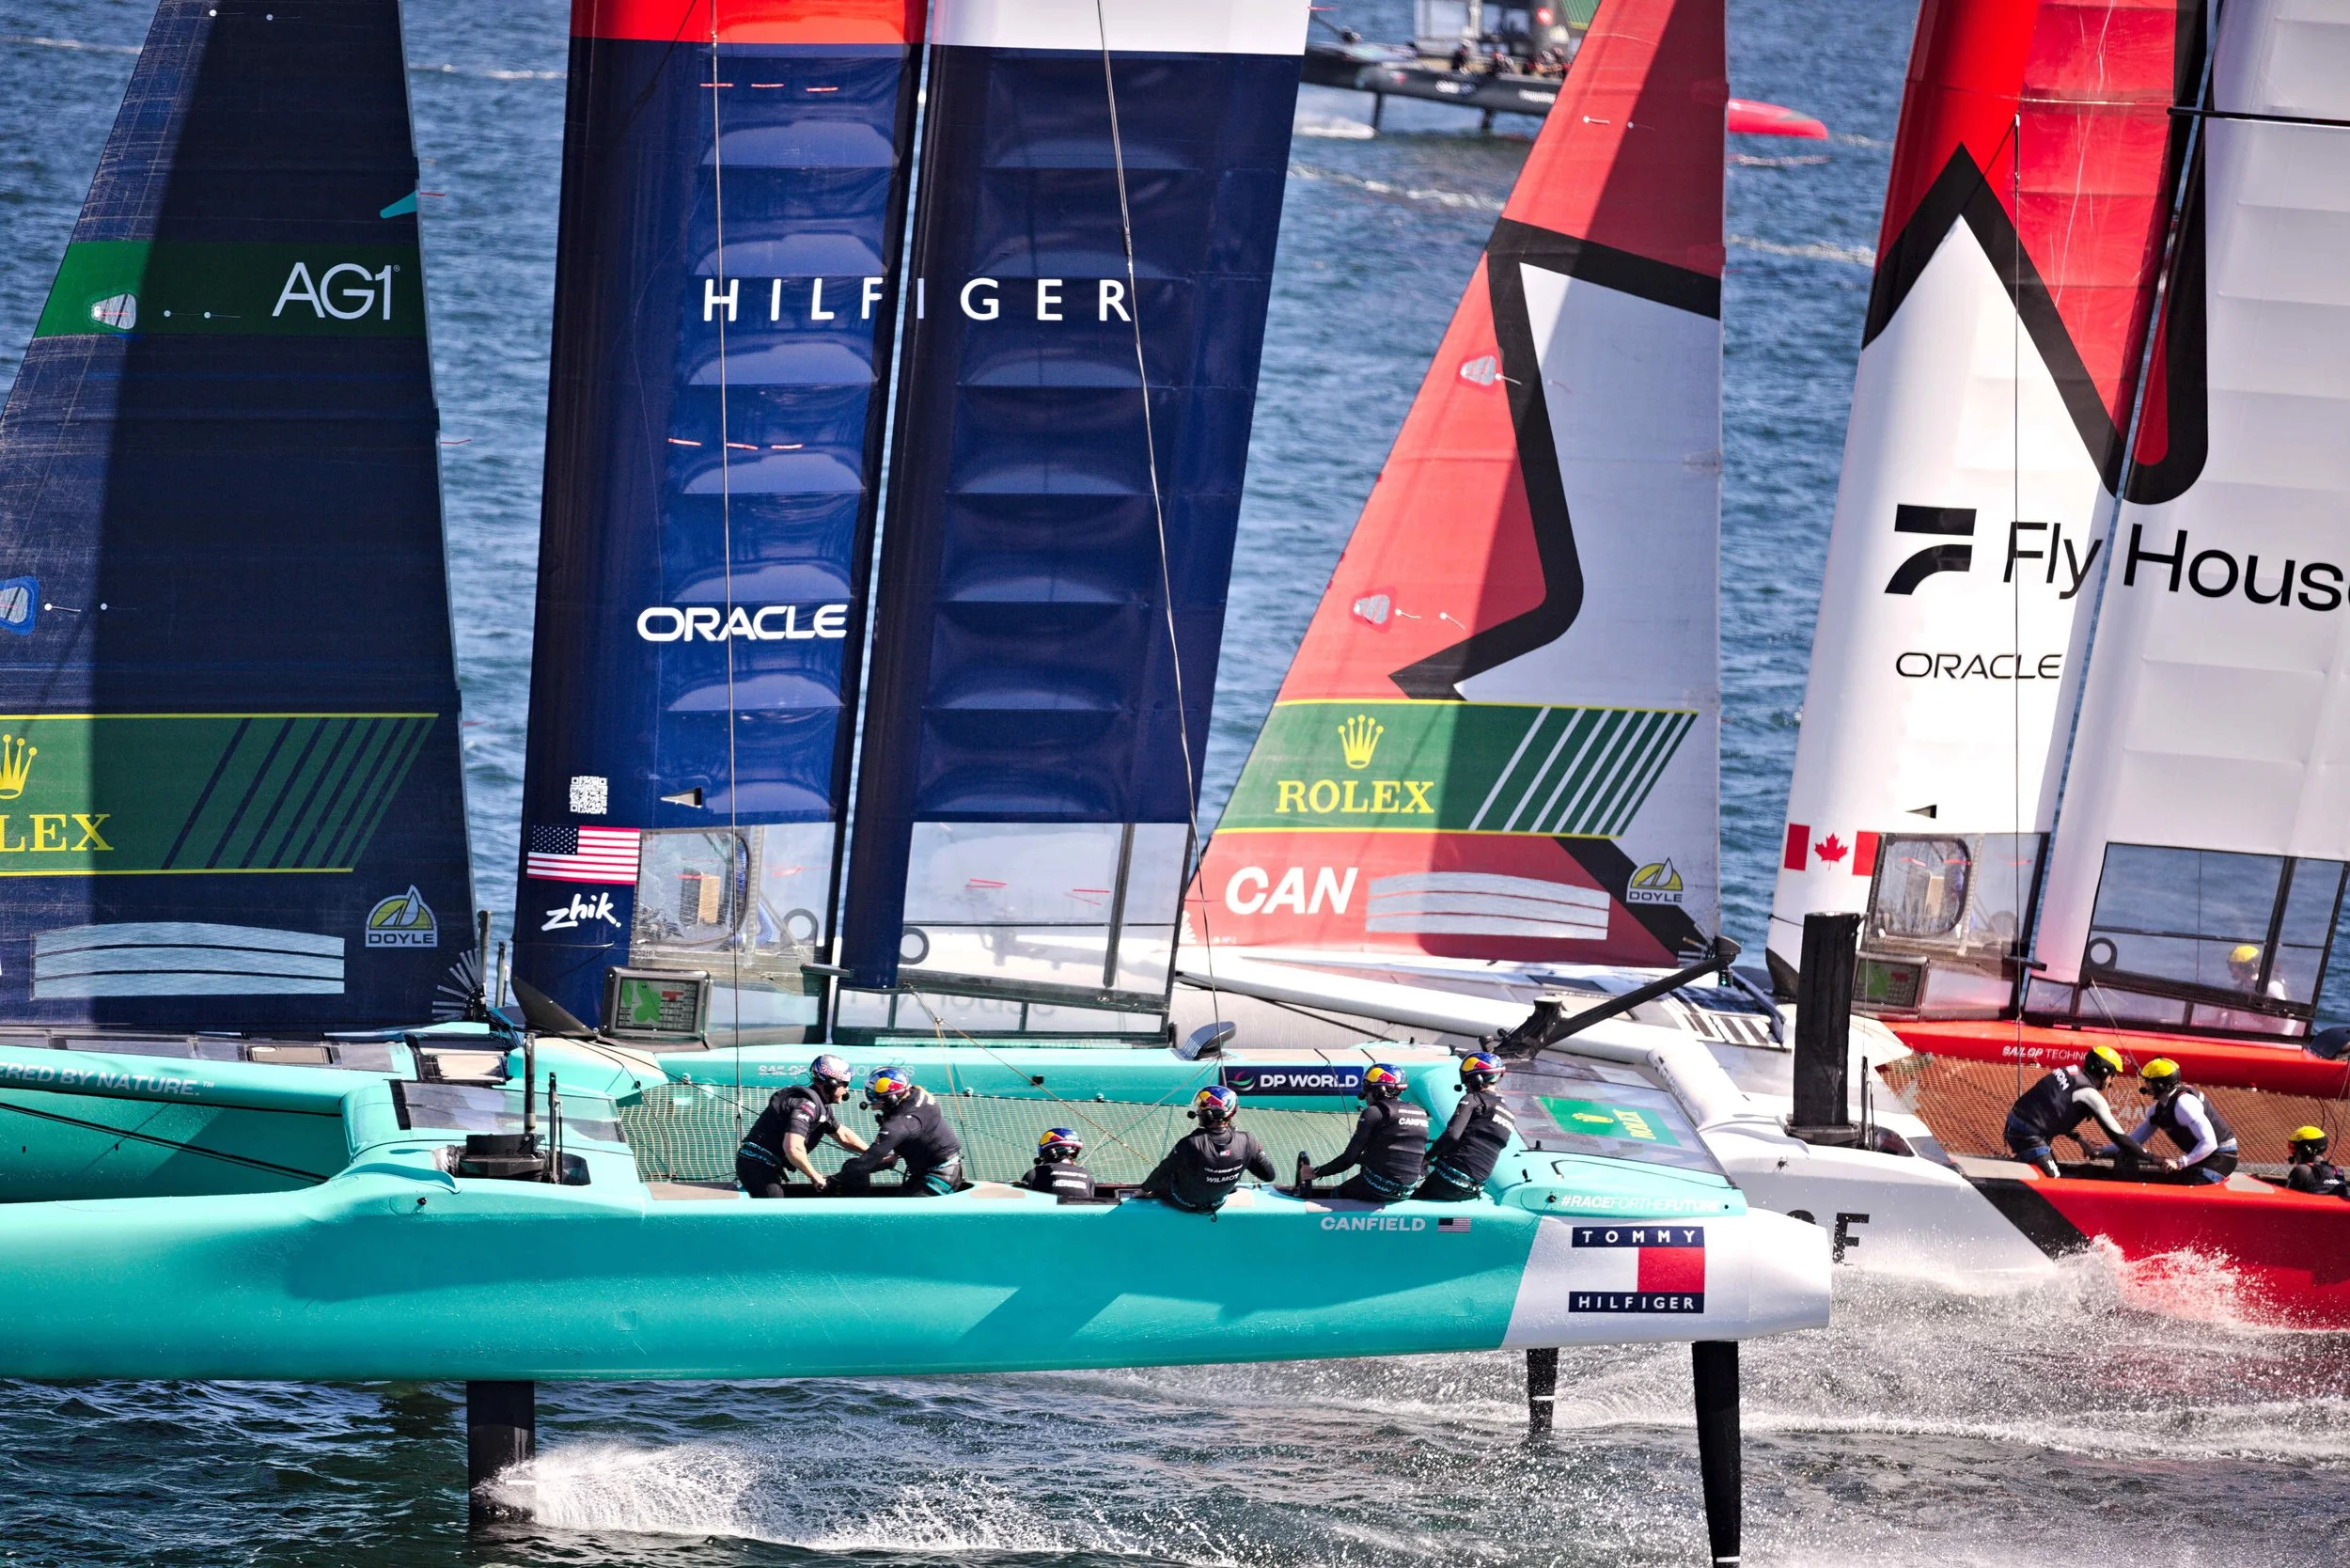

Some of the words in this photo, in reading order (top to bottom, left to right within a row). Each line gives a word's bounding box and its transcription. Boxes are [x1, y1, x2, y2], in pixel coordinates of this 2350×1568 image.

[273, 261, 392, 321] AG1
[703, 276, 1135, 322] HILFIGER
[2003, 521, 2104, 600] Fly
[2123, 523, 2350, 612] Hous
[636, 604, 848, 642] ORACLE
[1895, 651, 2063, 680] ORACLE
[1275, 779, 1434, 814] ROLEX
[1225, 866, 1358, 917] CAN
[1628, 890, 1684, 903] DOYLE
[368, 933, 435, 945] DOYLE
[0, 1061, 55, 1082] RED
[59, 1068, 93, 1086] BY
[1260, 1074, 1288, 1088] DP
[1289, 1074, 1359, 1088] WORLD
[1320, 1216, 1427, 1231] CANFIELD
[1581, 1230, 1696, 1244] TOMMY
[1578, 1295, 1695, 1310] HILFIGER
